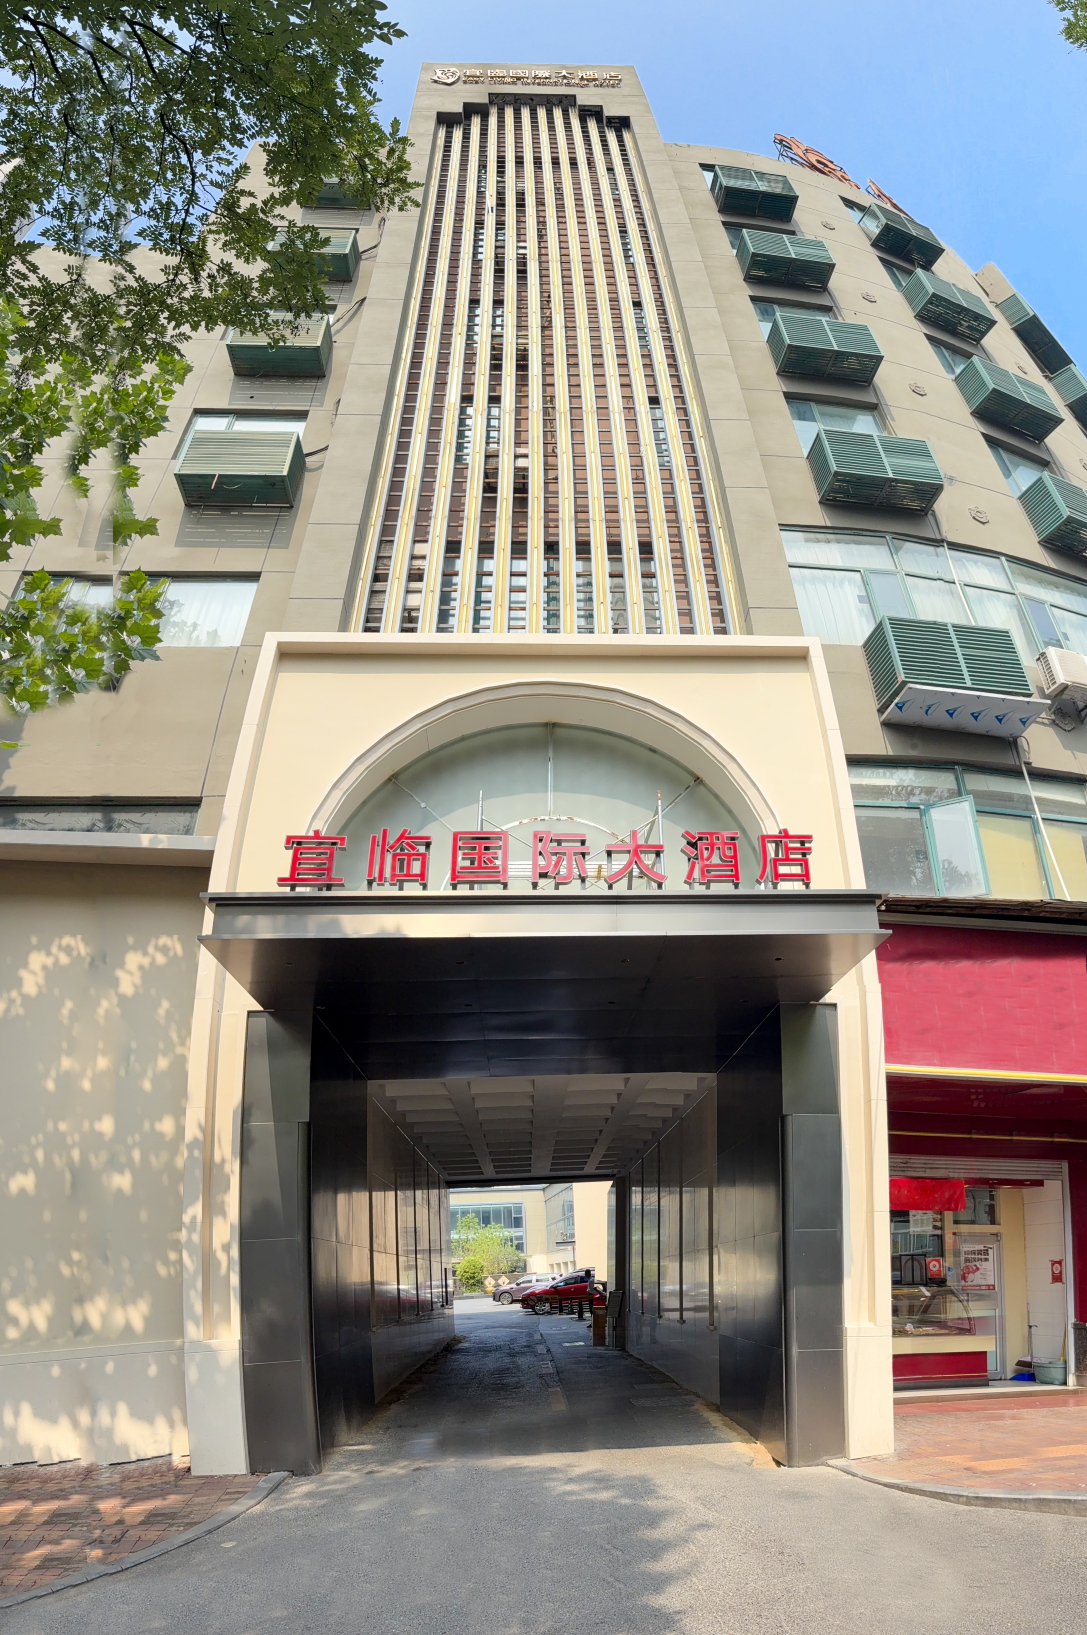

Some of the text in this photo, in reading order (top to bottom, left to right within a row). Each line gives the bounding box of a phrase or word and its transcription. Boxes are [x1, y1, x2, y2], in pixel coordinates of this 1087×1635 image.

[277, 827, 814, 886] 宜临国际大酒店
